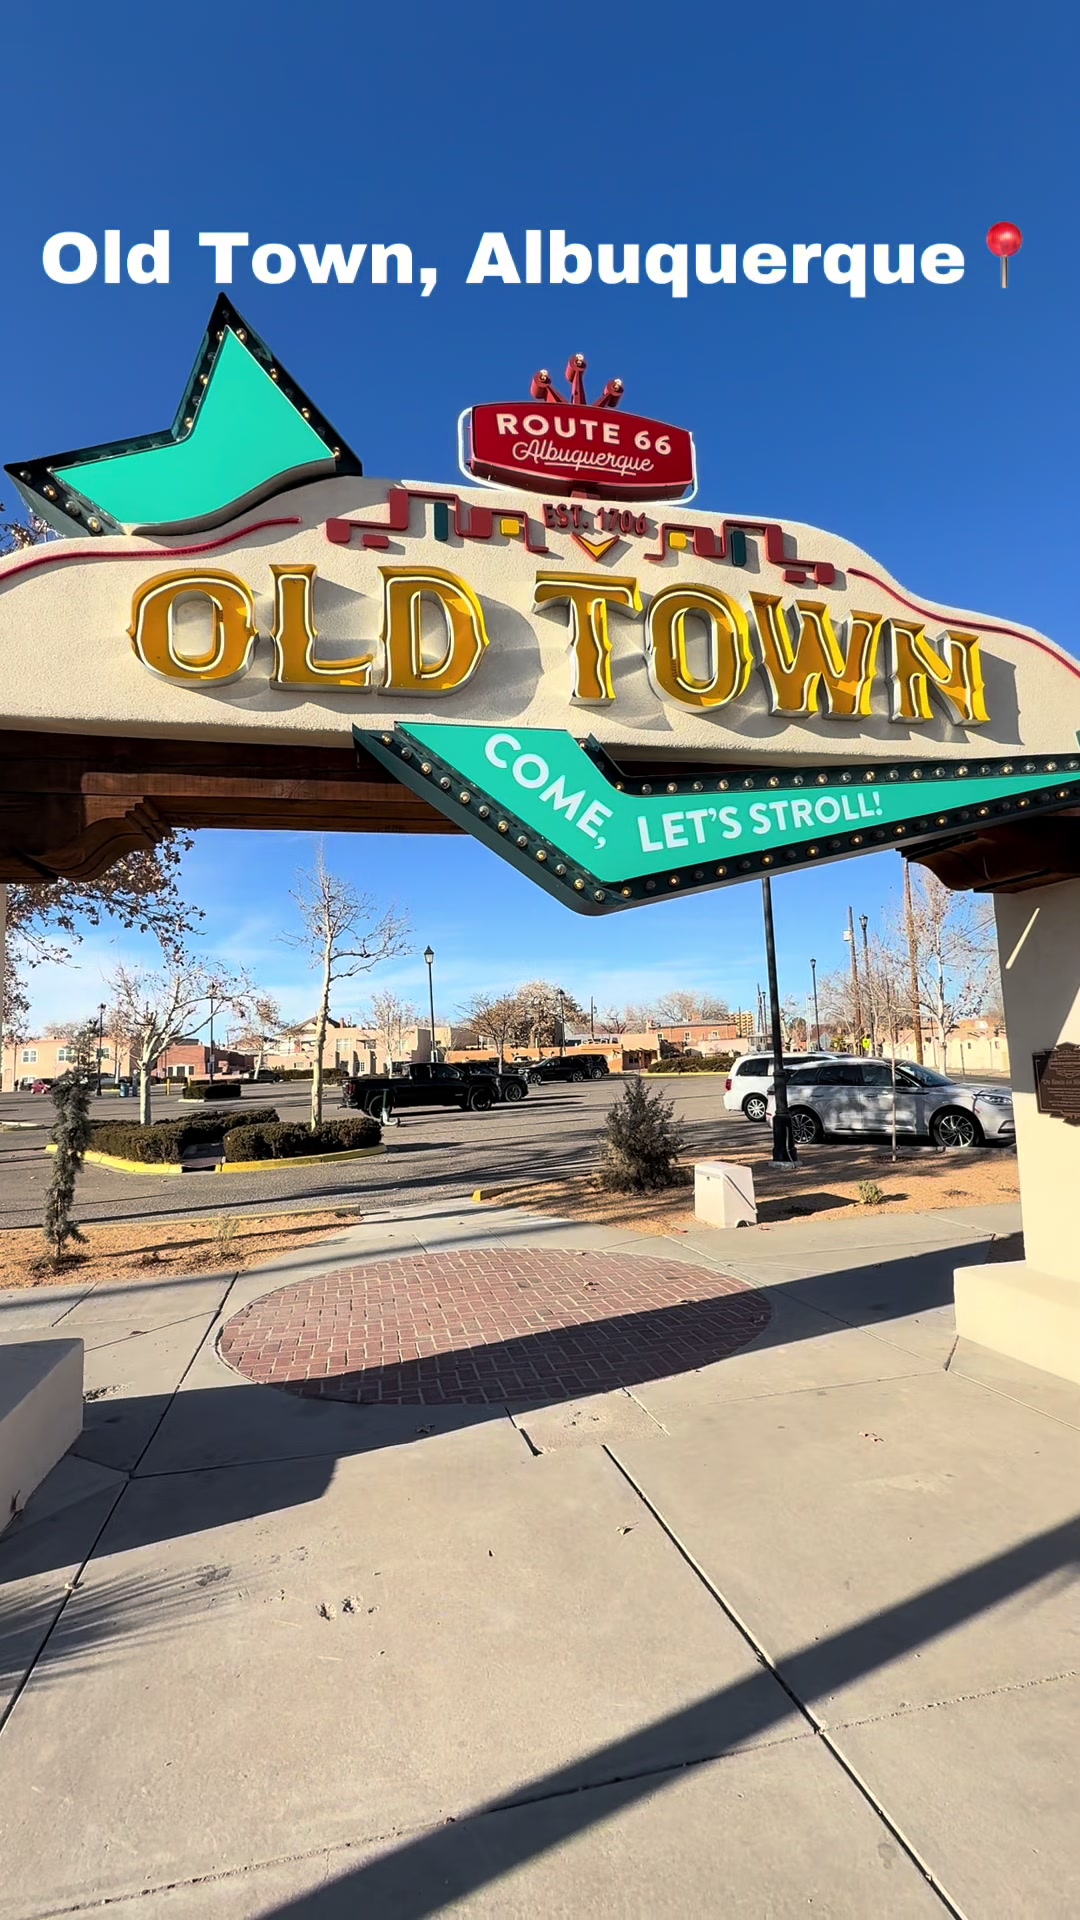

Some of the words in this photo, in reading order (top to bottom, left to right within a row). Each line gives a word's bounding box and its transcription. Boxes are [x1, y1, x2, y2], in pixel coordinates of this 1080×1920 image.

[496, 413, 621, 445] ROUTE
[634, 430, 672, 455] 66
[512, 439, 654, 477] Albuquerque
[543, 504, 589, 528] EST.
[597, 507, 648, 535] 1706
[126, 564, 490, 696] OLD
[531, 570, 991, 727] TOWN
[484, 733, 614, 850] COME,
[637, 806, 742, 852] LET'S
[749, 791, 883, 835] STROLL!
